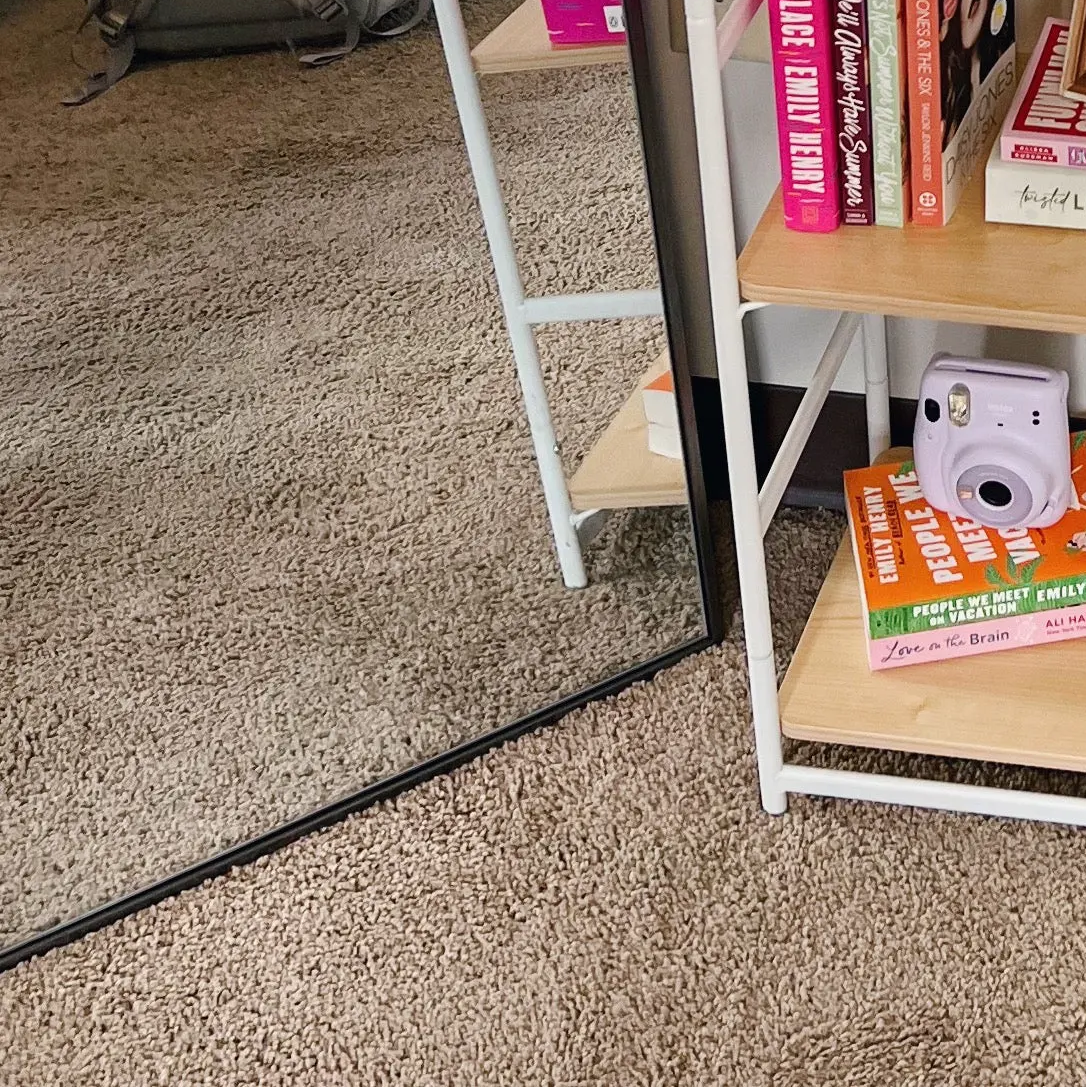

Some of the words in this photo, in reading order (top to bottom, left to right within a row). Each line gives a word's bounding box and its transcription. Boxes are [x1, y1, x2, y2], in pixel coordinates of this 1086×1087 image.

[834, 28, 862, 91] Always
[917, 38, 931, 49] &
[917, 51, 932, 74] THE
[870, 36, 897, 105] Summer
[918, 77, 932, 96] SIX
[784, 66, 821, 124] EMILY
[837, 91, 866, 137] Have
[789, 132, 825, 193] HENRY
[839, 132, 868, 207] Summer
[1016, 184, 1071, 212] twisted
[888, 471, 924, 505] WE
[863, 487, 890, 533] HENRY
[904, 507, 964, 585] PEOPLE
[947, 511, 998, 563] MEE
[873, 538, 899, 584] EMILY
[912, 599, 967, 618] PEOPLE
[968, 594, 991, 608] WE
[992, 586, 1030, 605] MEET
[1036, 584, 1086, 603] EMILY
[949, 603, 1017, 626] VACATION
[1045, 616, 1065, 629] ALI
[881, 640, 924, 663] Love
[928, 641, 942, 651] on
[969, 630, 1010, 646] Brain
